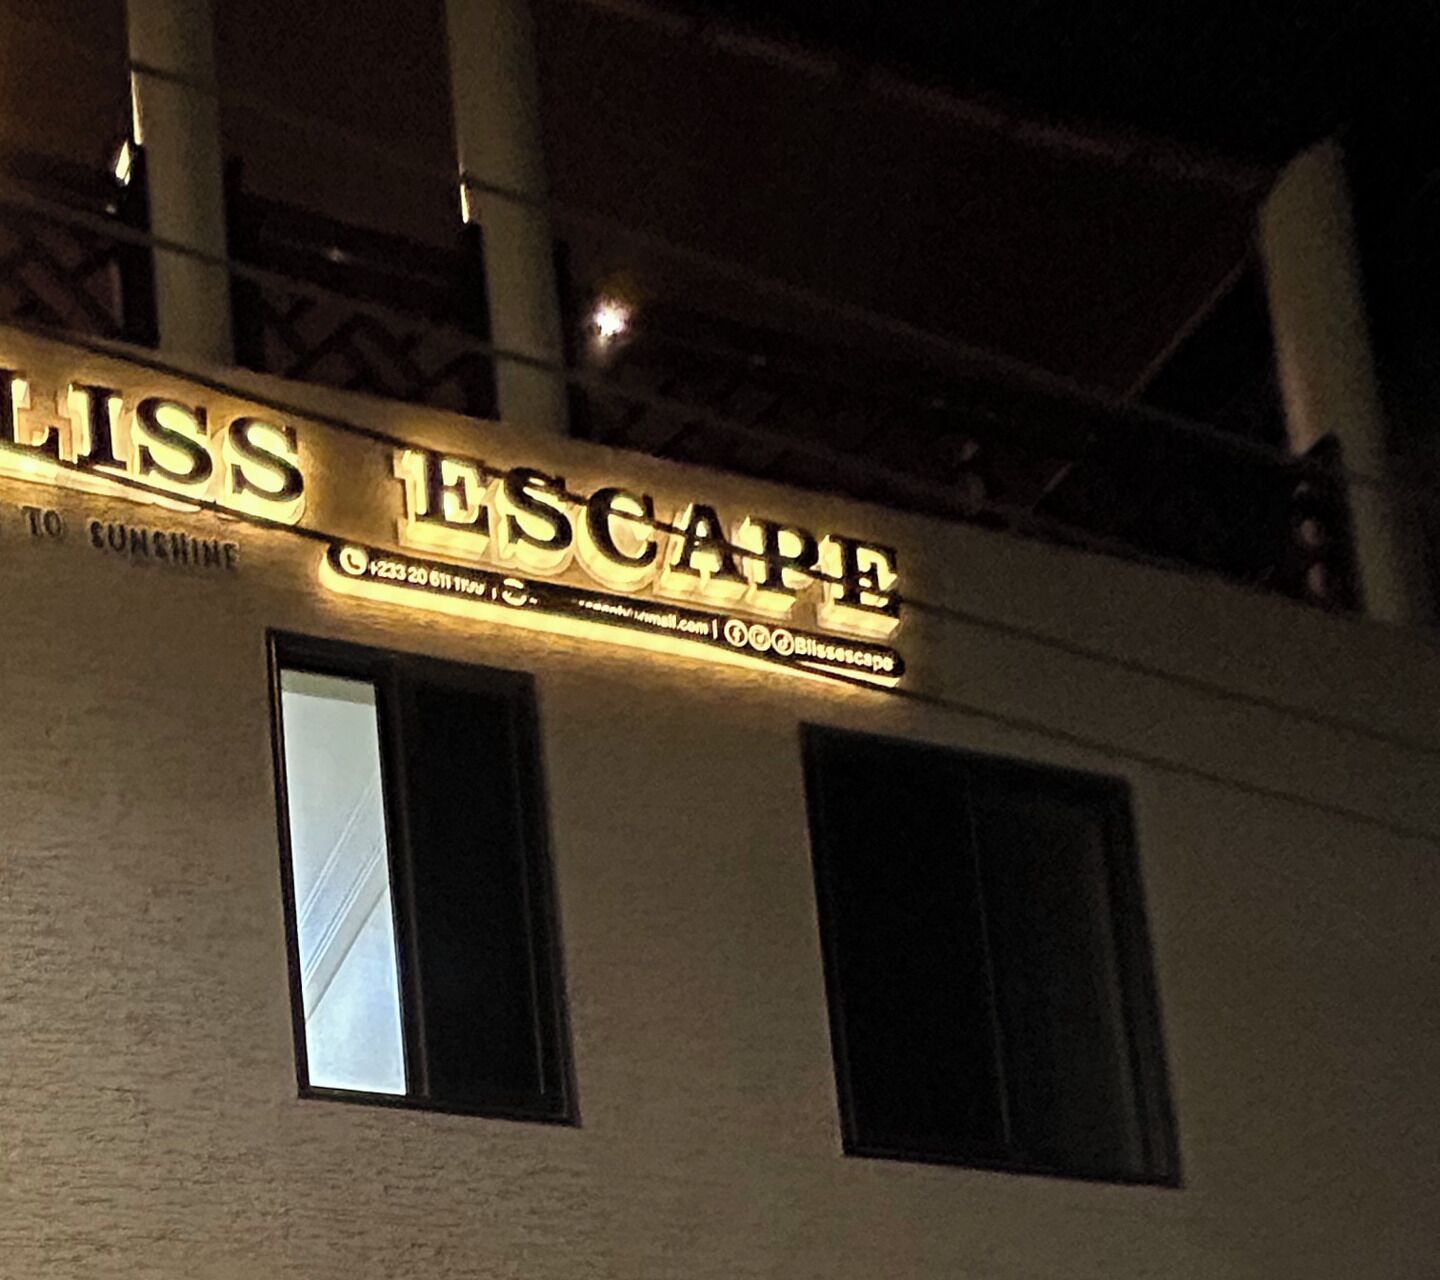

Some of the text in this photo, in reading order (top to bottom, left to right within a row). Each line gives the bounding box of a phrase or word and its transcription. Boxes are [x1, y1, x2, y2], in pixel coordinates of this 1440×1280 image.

[23, 504, 64, 538] TO
[88, 519, 241, 571] SUNSHINE
[396, 449, 901, 616] ESCAPE
[408, 567, 428, 585] 20
